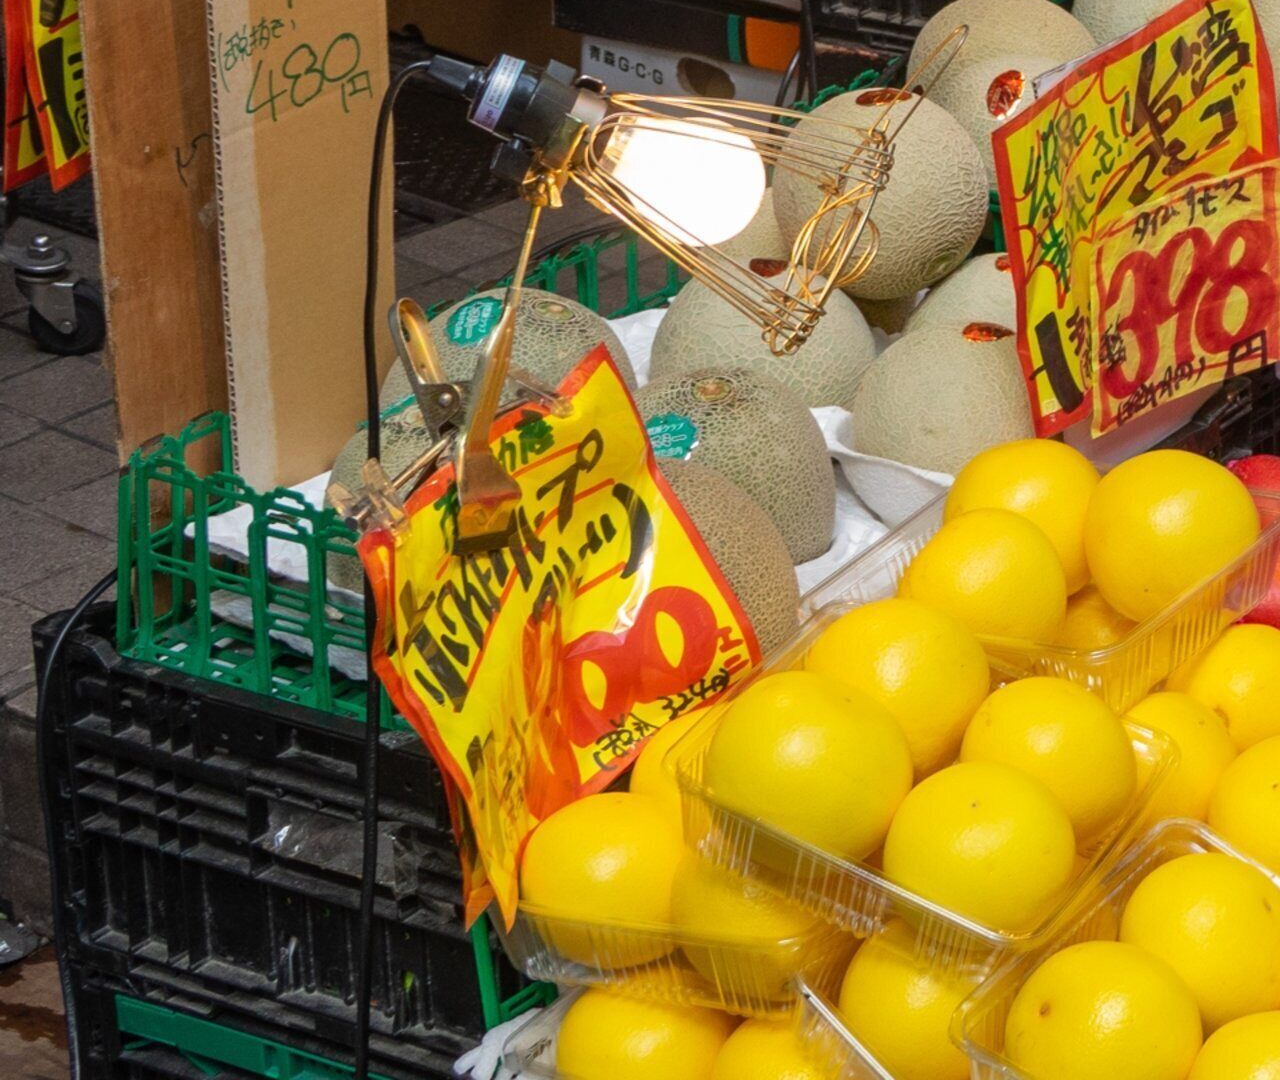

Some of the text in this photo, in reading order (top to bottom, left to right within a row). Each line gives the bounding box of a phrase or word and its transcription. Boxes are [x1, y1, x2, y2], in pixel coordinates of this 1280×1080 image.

[245, 31, 375, 124] 480円
[1129, 0, 1253, 140] 台湾
[1098, 219, 1276, 400] 398
